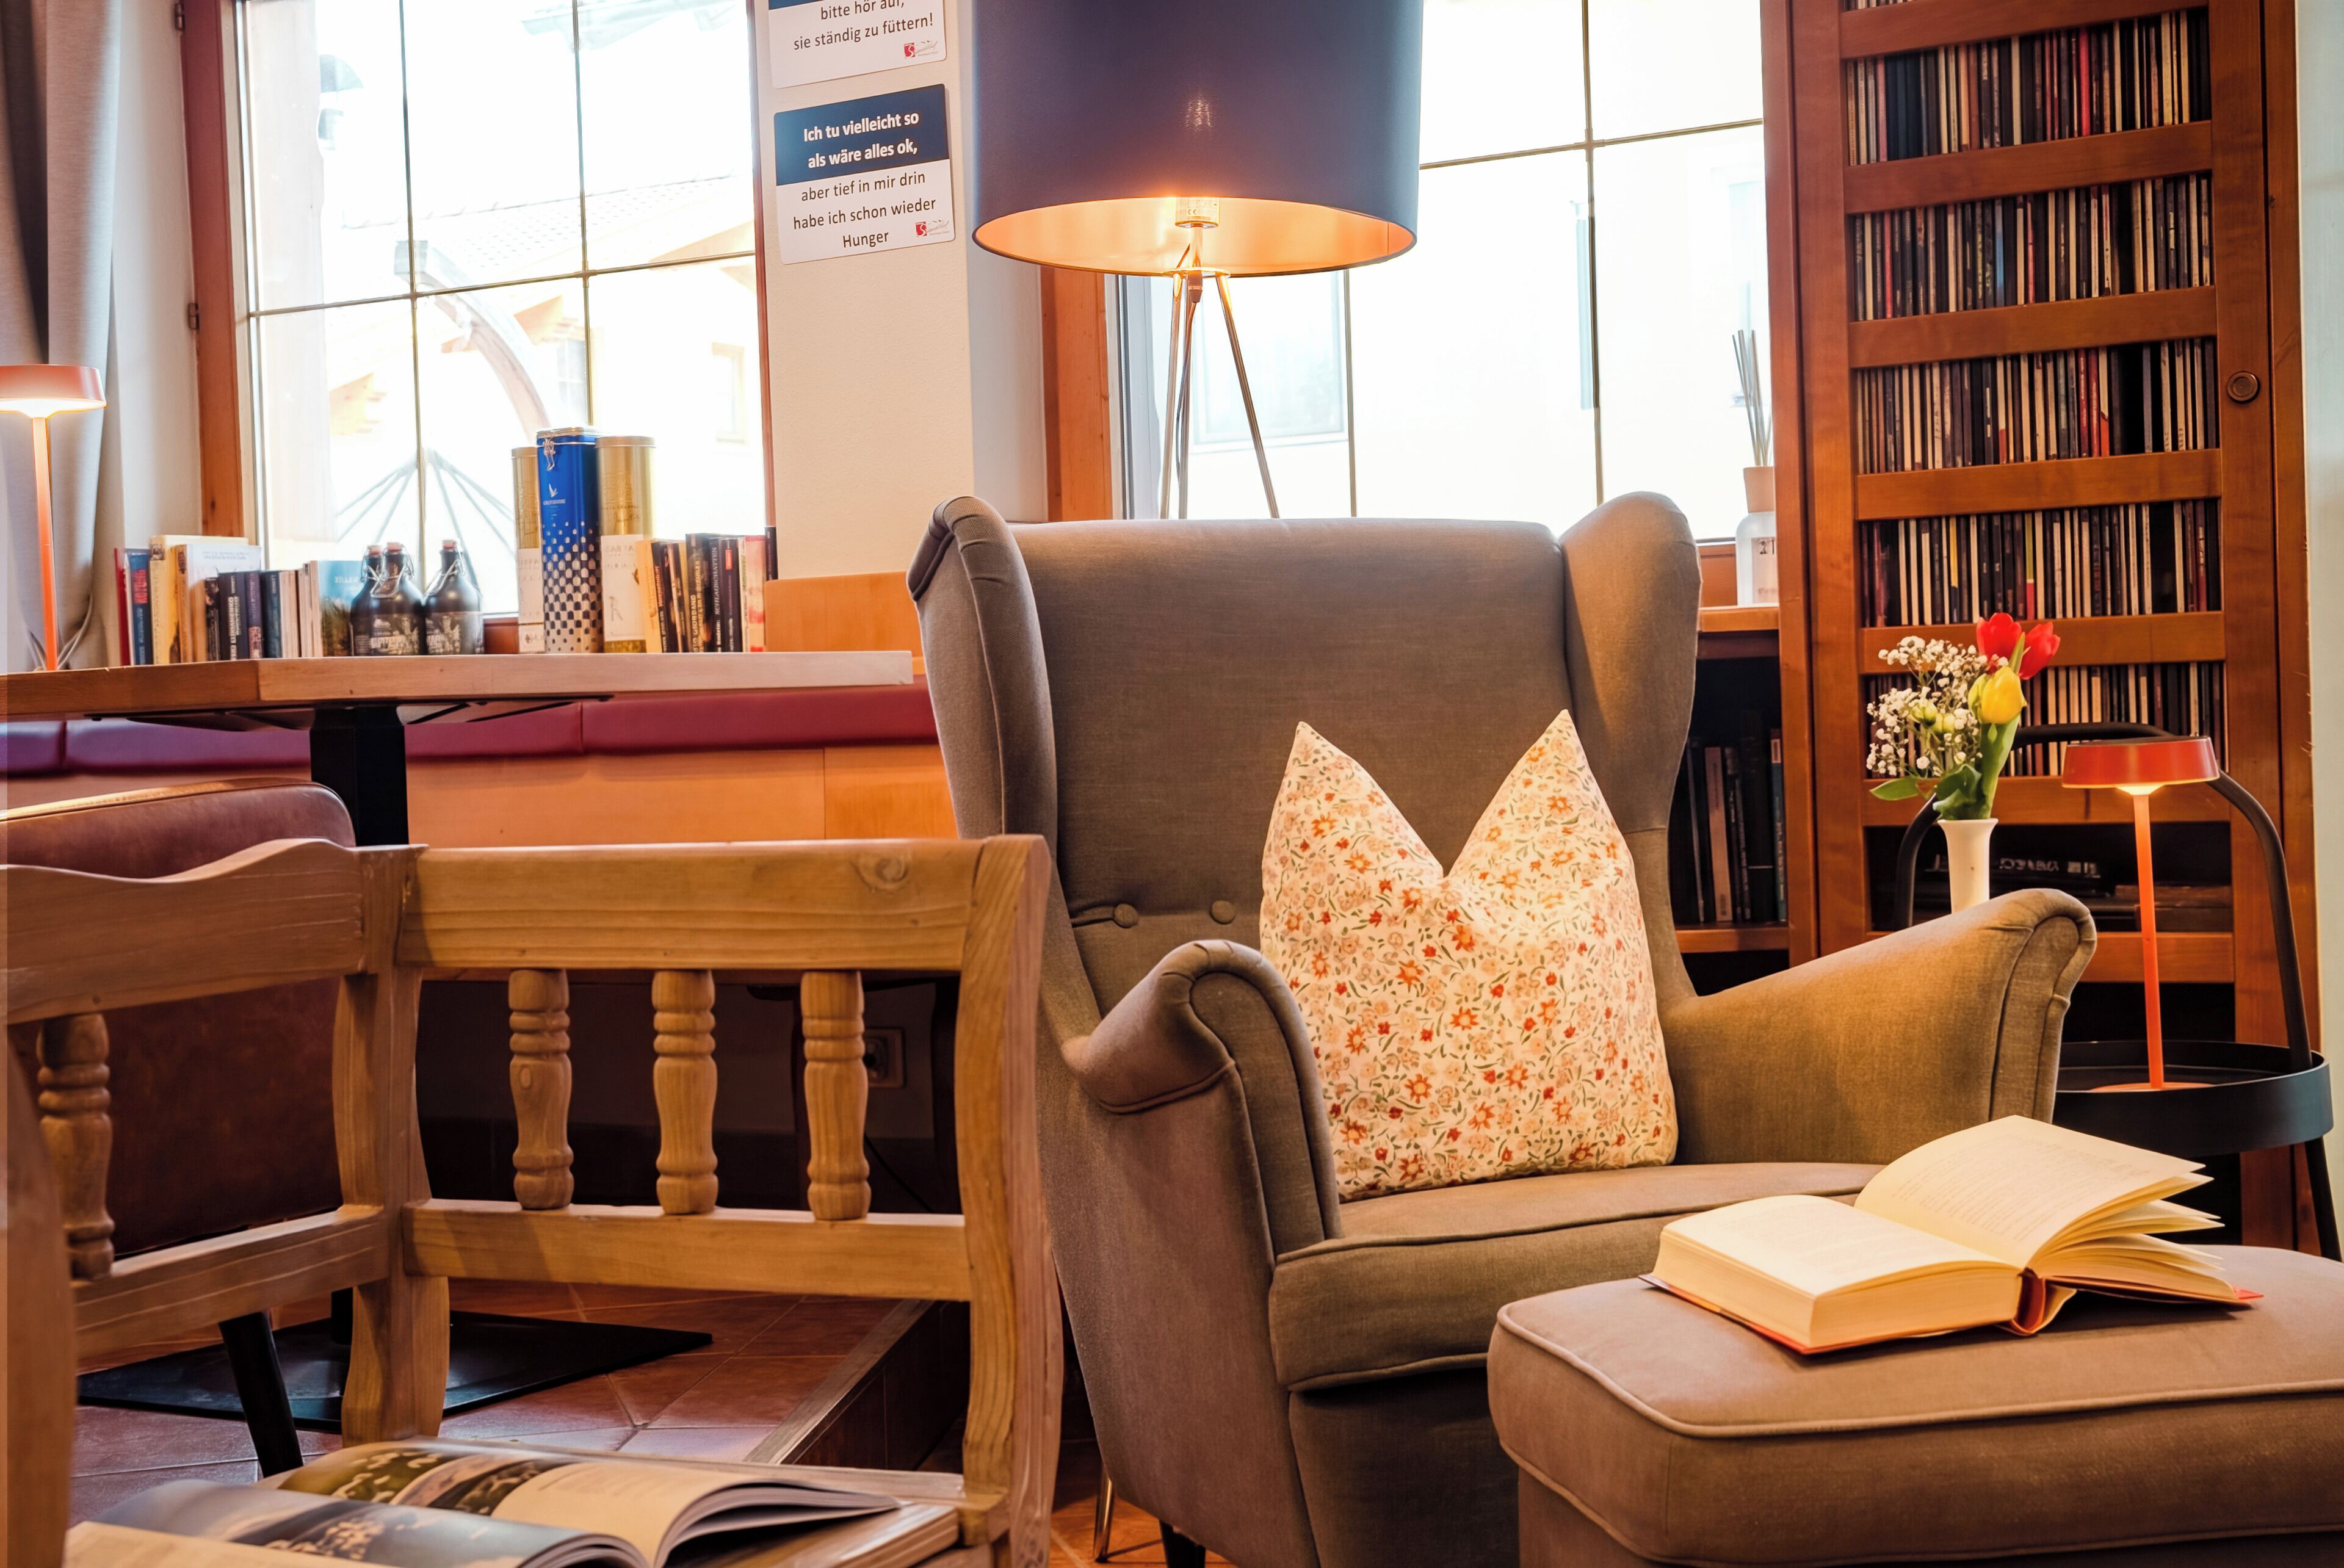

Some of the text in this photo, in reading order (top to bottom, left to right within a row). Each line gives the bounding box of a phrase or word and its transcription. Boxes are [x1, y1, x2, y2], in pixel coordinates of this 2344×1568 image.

[820, 5, 850, 20] bitte
[855, 0, 876, 14] hör
[794, 13, 932, 49] sie ständig zu füttern!
[804, 114, 919, 142] Ich tu vielleicht so
[808, 139, 917, 168] als wäre alles ok,
[802, 172, 925, 201] aber tief in mir drin
[794, 198, 935, 229] habe ich schon wieder
[843, 233, 888, 248] Hunger
[712, 547, 720, 615] SCHLAGSCHATTEN
